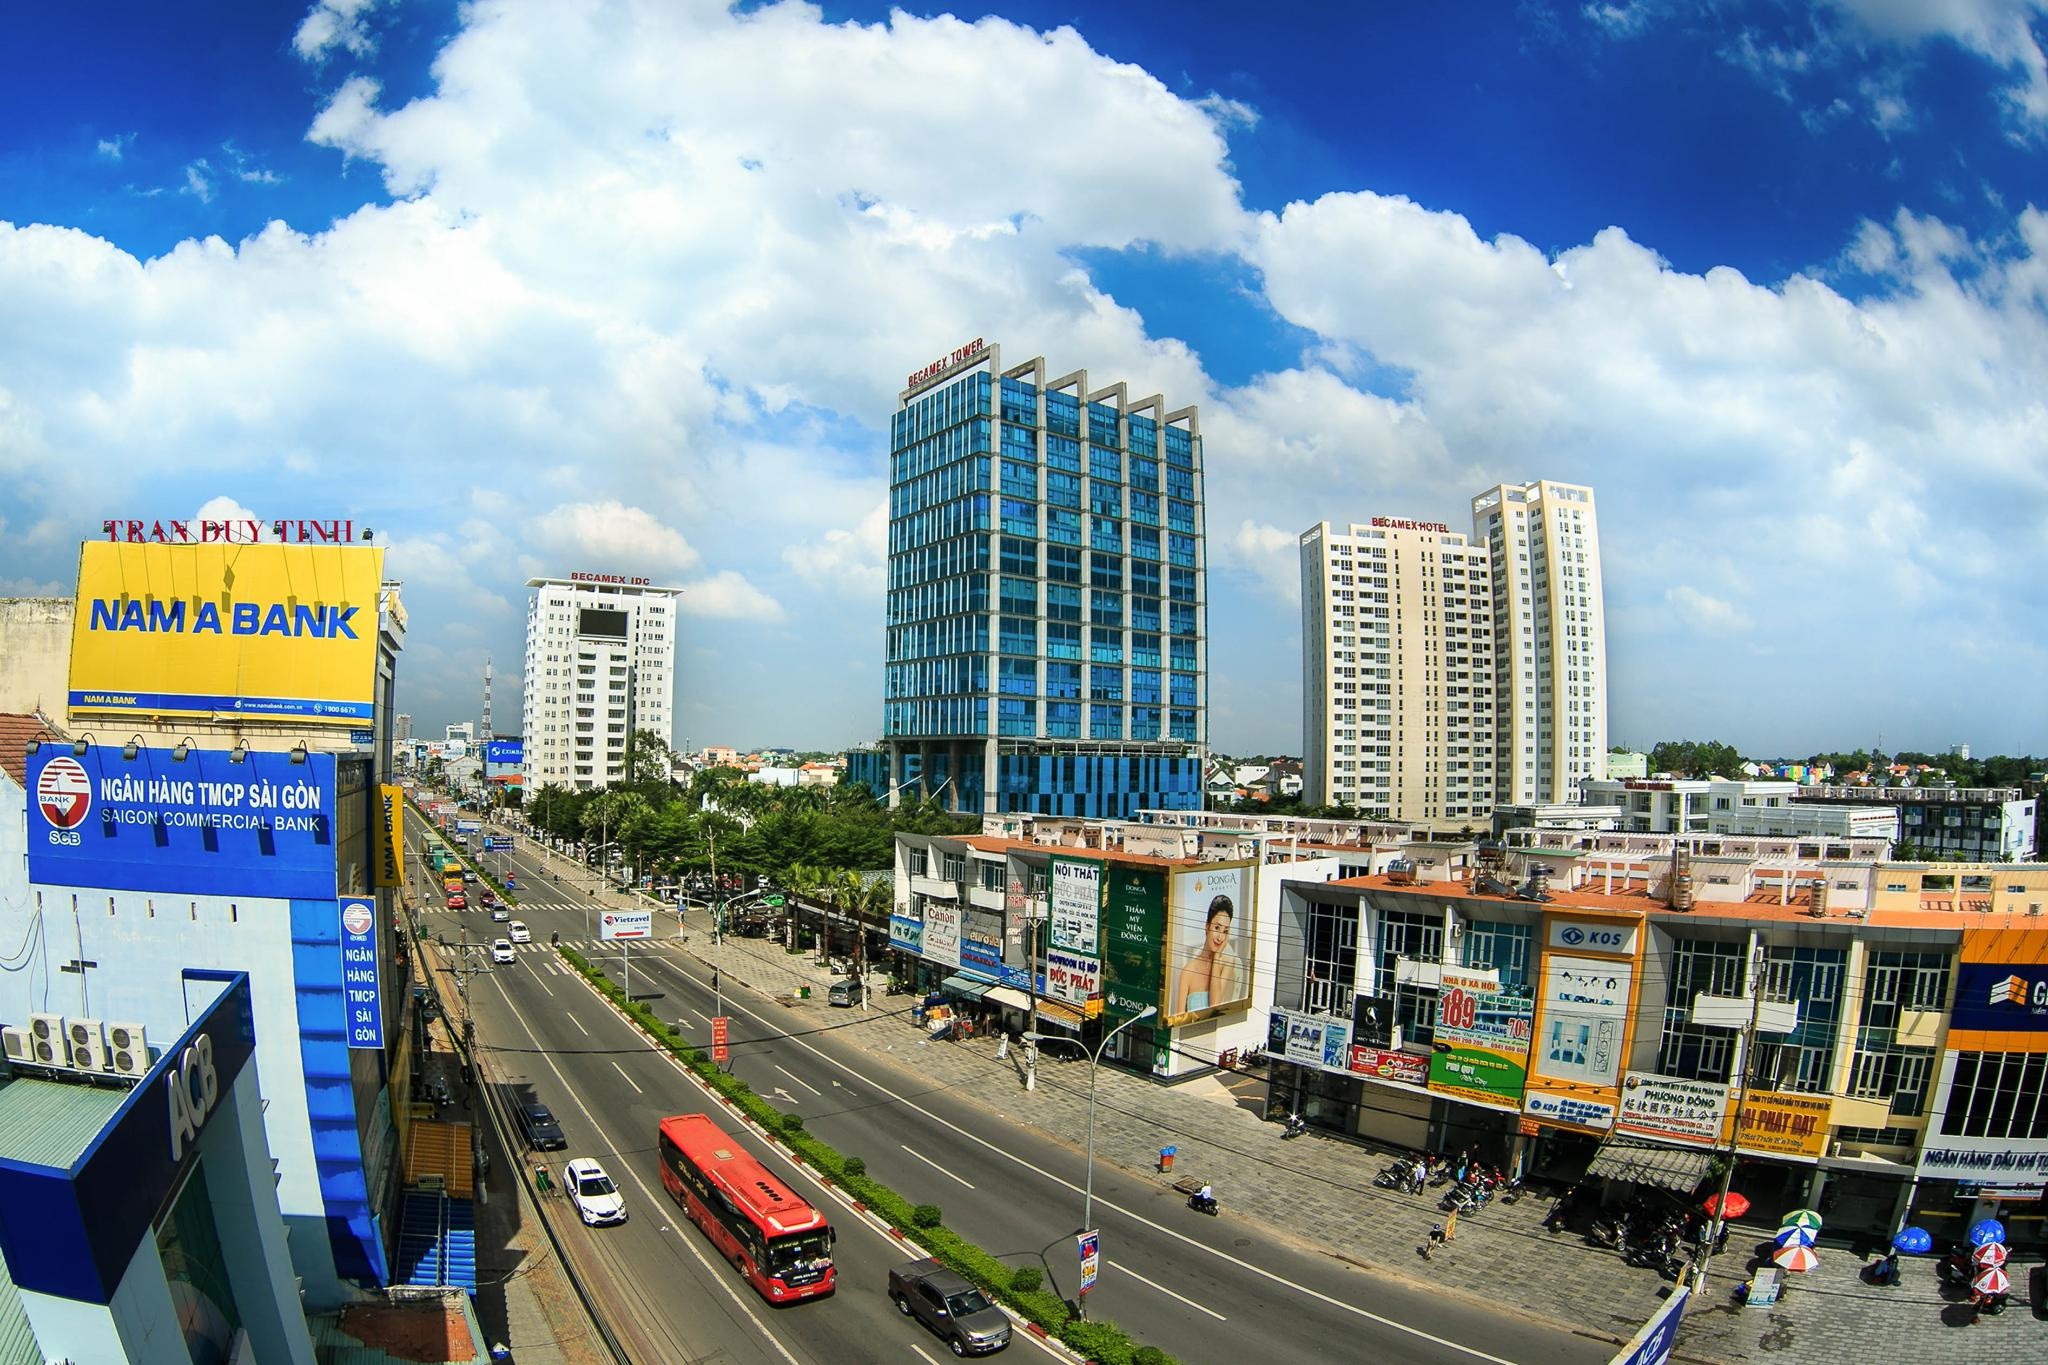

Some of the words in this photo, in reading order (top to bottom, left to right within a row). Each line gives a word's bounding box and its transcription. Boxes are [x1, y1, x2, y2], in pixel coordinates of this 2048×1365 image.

[908, 356, 947, 388] BECAMEX
[951, 337, 983, 364] TOWER
[104, 520, 190, 543] TRAN
[200, 520, 266, 543] DUY
[273, 520, 354, 543] TINH
[1371, 517, 1418, 531] BECAMEX
[1419, 521, 1449, 533] HOTEL
[571, 572, 626, 584] BECAMEX
[631, 576, 650, 585] IDC
[90, 598, 187, 633] NAM
[191, 602, 223, 635] A
[231, 602, 361, 640] BANK
[84, 695, 104, 704] NAM
[105, 696, 111, 704] A
[112, 696, 136, 705] BANK
[325, 705, 339, 713] 1900
[40, 795, 70, 804] BANK
[101, 773, 144, 802] NGÂN
[148, 775, 194, 805] HÀNG
[198, 781, 245, 807] TMCP
[249, 778, 277, 808] SÀI
[282, 780, 321, 809] GÒN
[101, 809, 158, 825] SAIGON
[163, 811, 270, 830] COMMERCIAL
[274, 817, 320, 832] BANK
[384, 794, 393, 833] BANK
[49, 830, 81, 846] SCB
[384, 836, 393, 845] A
[384, 847, 393, 880] NAM
[1055, 863, 1071, 879] NỘI
[1073, 864, 1099, 881] THẤT
[614, 915, 650, 923] Vietravel
[928, 907, 955, 925] Canon
[1589, 931, 1622, 946] KOS
[346, 947, 373, 962] NGÂN
[347, 967, 375, 982] HÀNG
[1070, 974, 1095, 993] PHÁT
[348, 990, 376, 1002] TMCP
[2033, 981, 2048, 1006] G
[356, 1008, 372, 1023] SÀI
[1442, 988, 1476, 1030] 189
[355, 1026, 376, 1041] GÒN
[1508, 1018, 1530, 1038] 70%
[167, 1033, 219, 1162] ACB
[1644, 1090, 1685, 1104] PHƯƠNG
[1686, 1094, 1716, 1109] ĐÔNG
[1756, 1108, 1791, 1135] PHÁT
[1790, 1113, 1818, 1140] ĐẠT
[1924, 1149, 1959, 1166] NGÂN
[1958, 1150, 1993, 1168] HÀNG
[1992, 1150, 2017, 1169] DẦU
[2016, 1152, 2038, 1169] KHÍ
